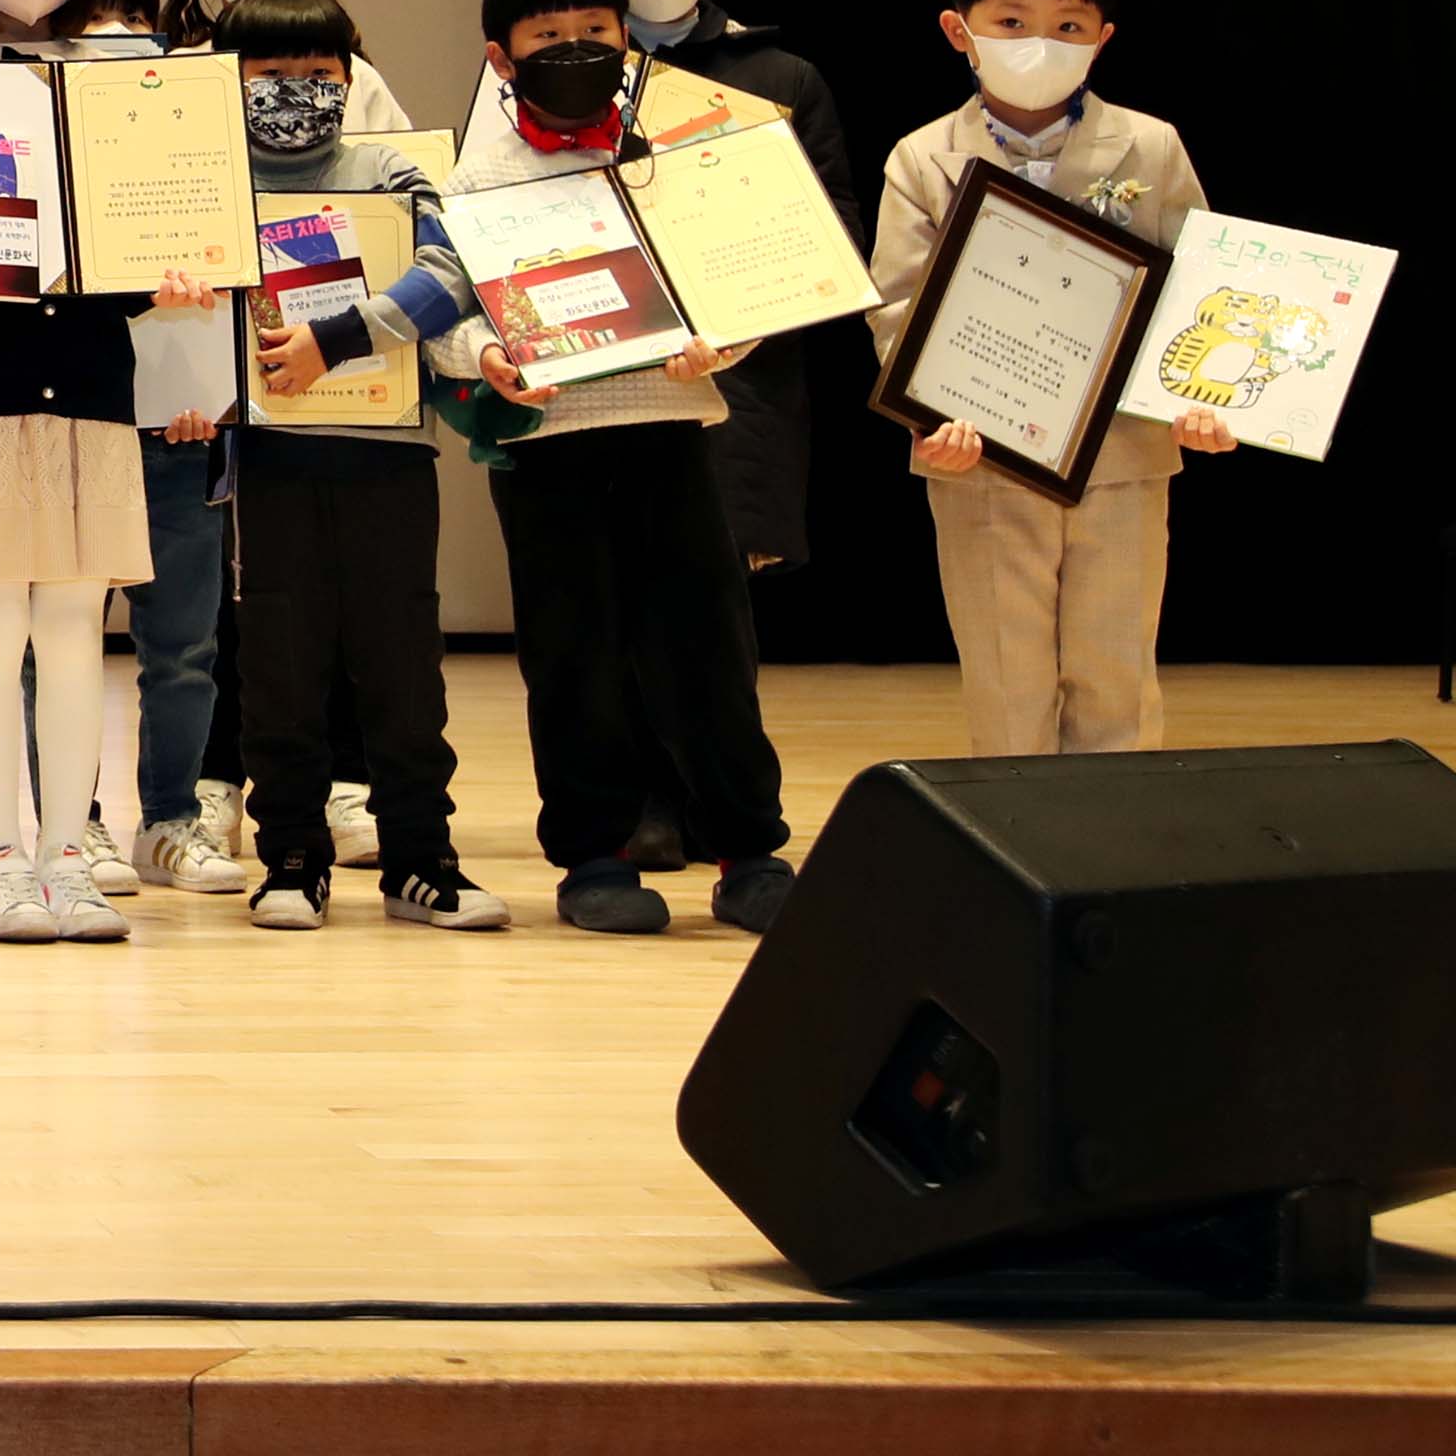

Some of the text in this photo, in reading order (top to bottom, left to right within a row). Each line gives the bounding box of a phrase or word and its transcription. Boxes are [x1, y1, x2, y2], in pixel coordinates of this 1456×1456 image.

[259, 213, 348, 244] 스터 차일드
[1208, 227, 1366, 288] 친구의 전설
